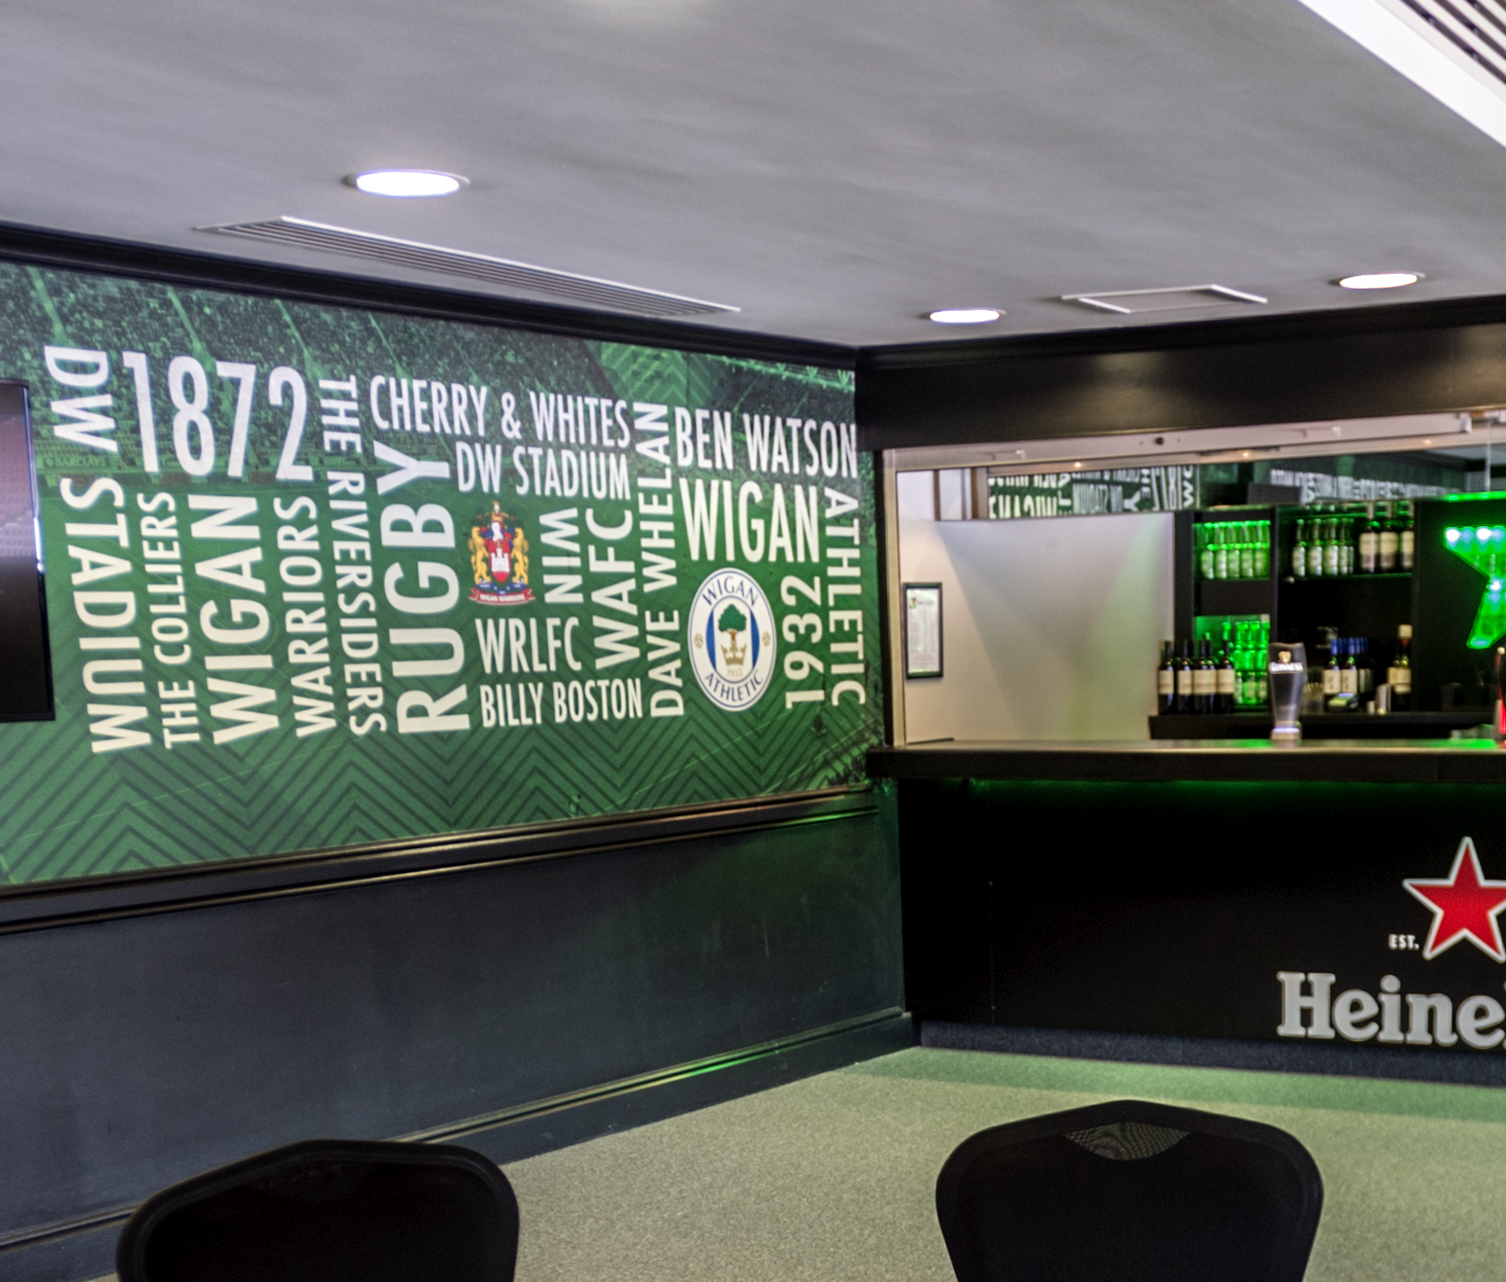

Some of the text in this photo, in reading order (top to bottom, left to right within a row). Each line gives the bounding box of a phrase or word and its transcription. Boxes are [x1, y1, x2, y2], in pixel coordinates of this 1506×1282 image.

[122, 350, 314, 482] 1872
[369, 373, 631, 450] CHERRY & WHITES
[455, 440, 631, 501] DW STADIUM
[674, 406, 858, 479] BEN WATSON
[43, 344, 152, 754] DW STADIUM
[318, 373, 387, 736] THE RIVERSIDERS
[372, 439, 471, 734] RUGBY
[633, 402, 684, 718] DAVE WHELAN
[678, 477, 820, 564] WIGAN
[137, 491, 201, 749] THE COLLIERS
[187, 494, 280, 745] WIGAN
[273, 495, 338, 738] WARRIORS
[475, 616, 582, 674] WRLFC
[585, 507, 642, 670] WAFC
[701, 575, 759, 607] WIGAN
[781, 575, 825, 709] 1932
[824, 486, 866, 707] ATHLETIC
[479, 676, 643, 729] BILLY BOSTON
[704, 668, 764, 702] ATHLETIC
[1388, 933, 1420, 951] EST.
